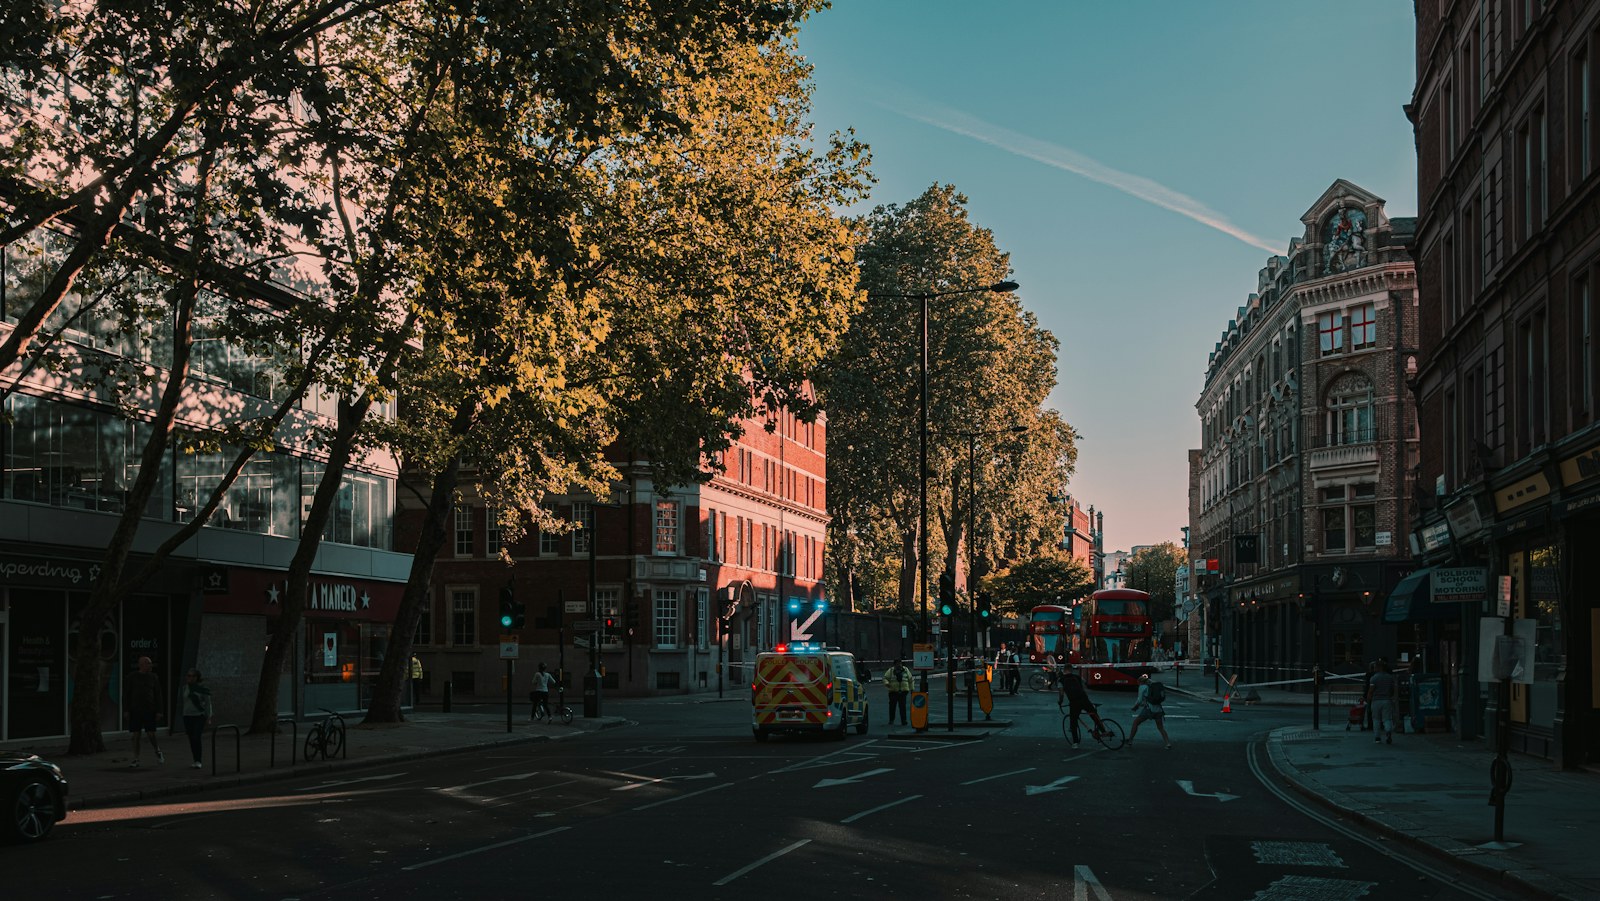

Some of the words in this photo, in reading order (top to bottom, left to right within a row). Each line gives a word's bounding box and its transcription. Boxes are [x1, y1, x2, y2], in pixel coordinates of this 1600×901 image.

[1436, 570, 1482, 578] HOLBORN
[1440, 576, 1480, 584] SCHOOL
[1435, 586, 1486, 594] MOTORING
[320, 583, 357, 612] MANGER
[130, 637, 152, 649] order
